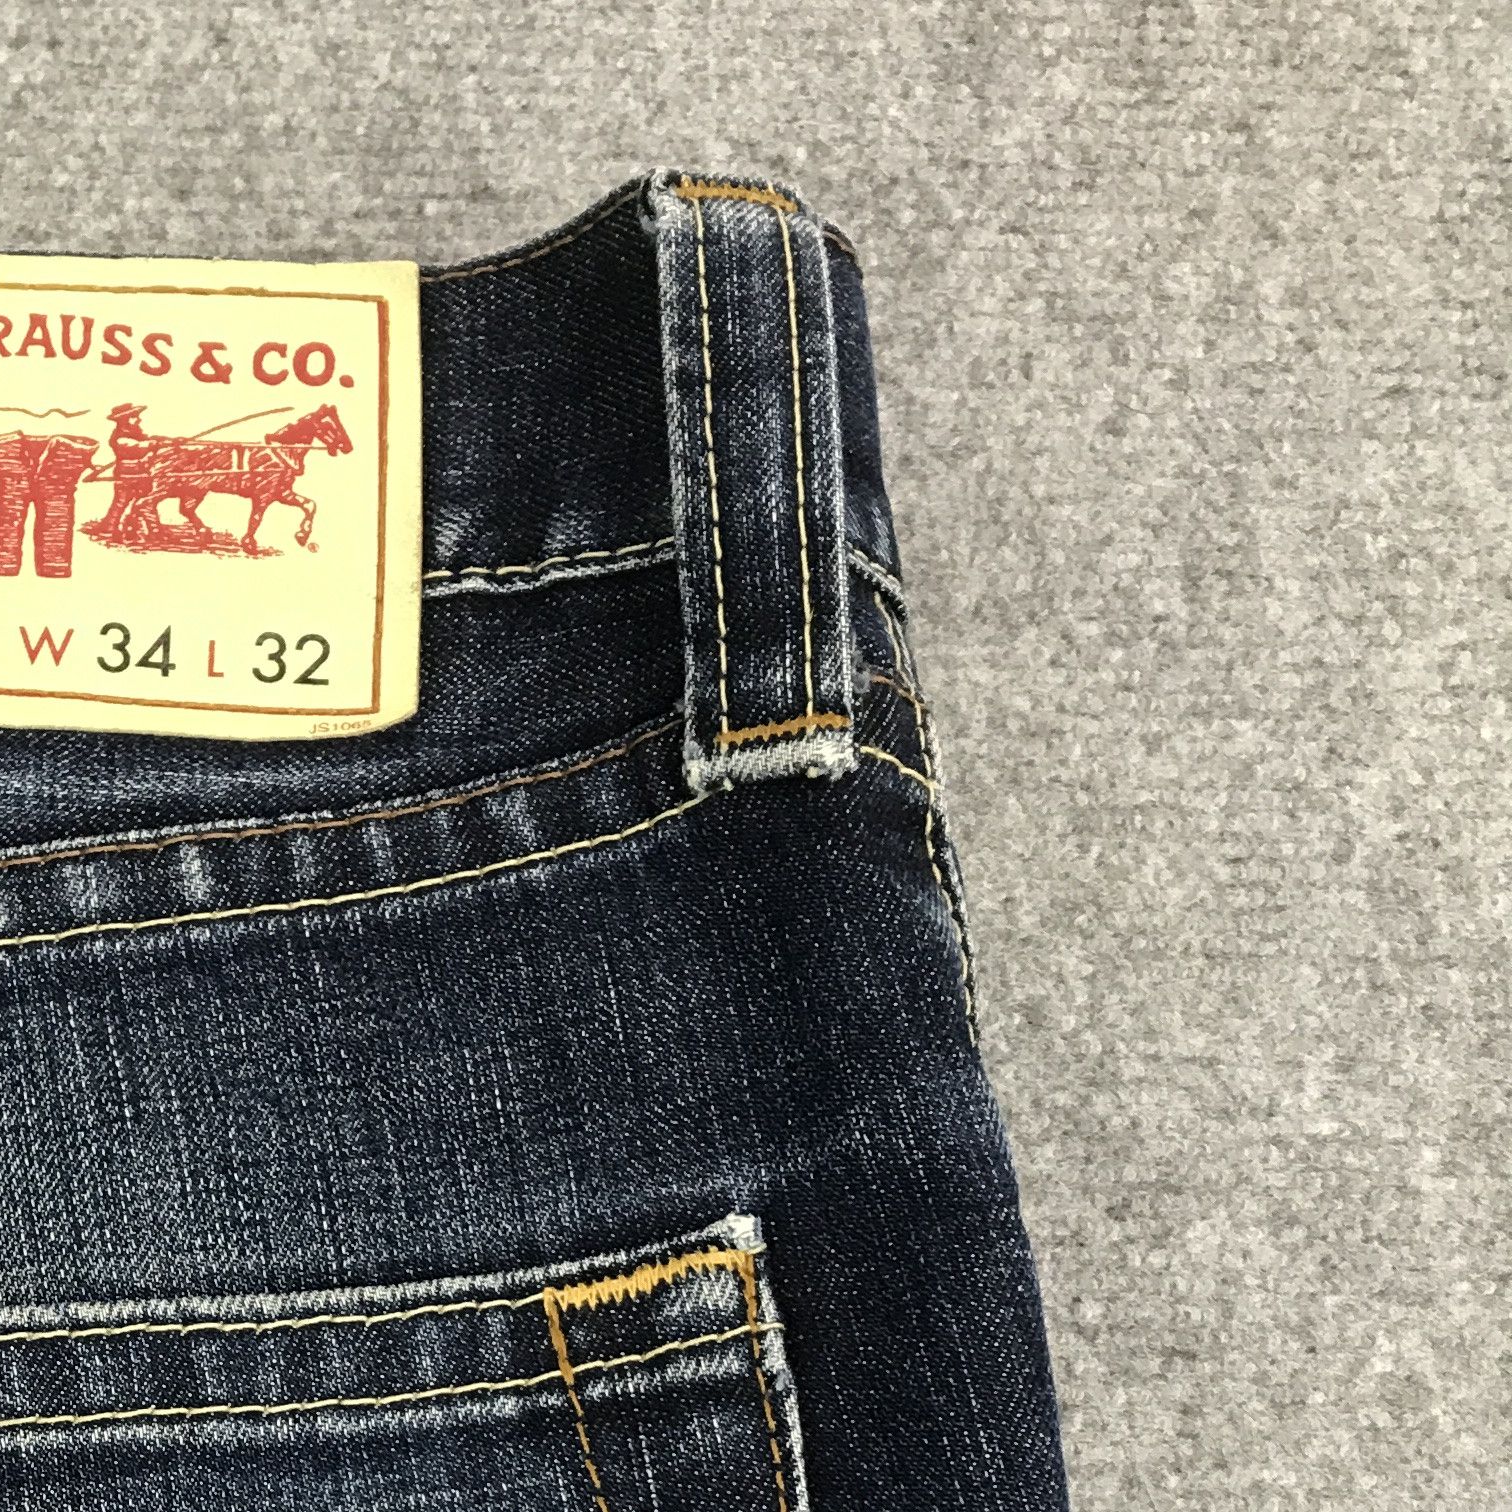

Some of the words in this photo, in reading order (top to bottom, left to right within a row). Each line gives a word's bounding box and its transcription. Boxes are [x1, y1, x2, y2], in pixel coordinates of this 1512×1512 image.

[190, 341, 232, 386] &
[252, 340, 355, 388] CO.
[18, 627, 73, 666] W
[97, 622, 176, 679] 34
[207, 638, 224, 678] L
[251, 631, 331, 685] 32
